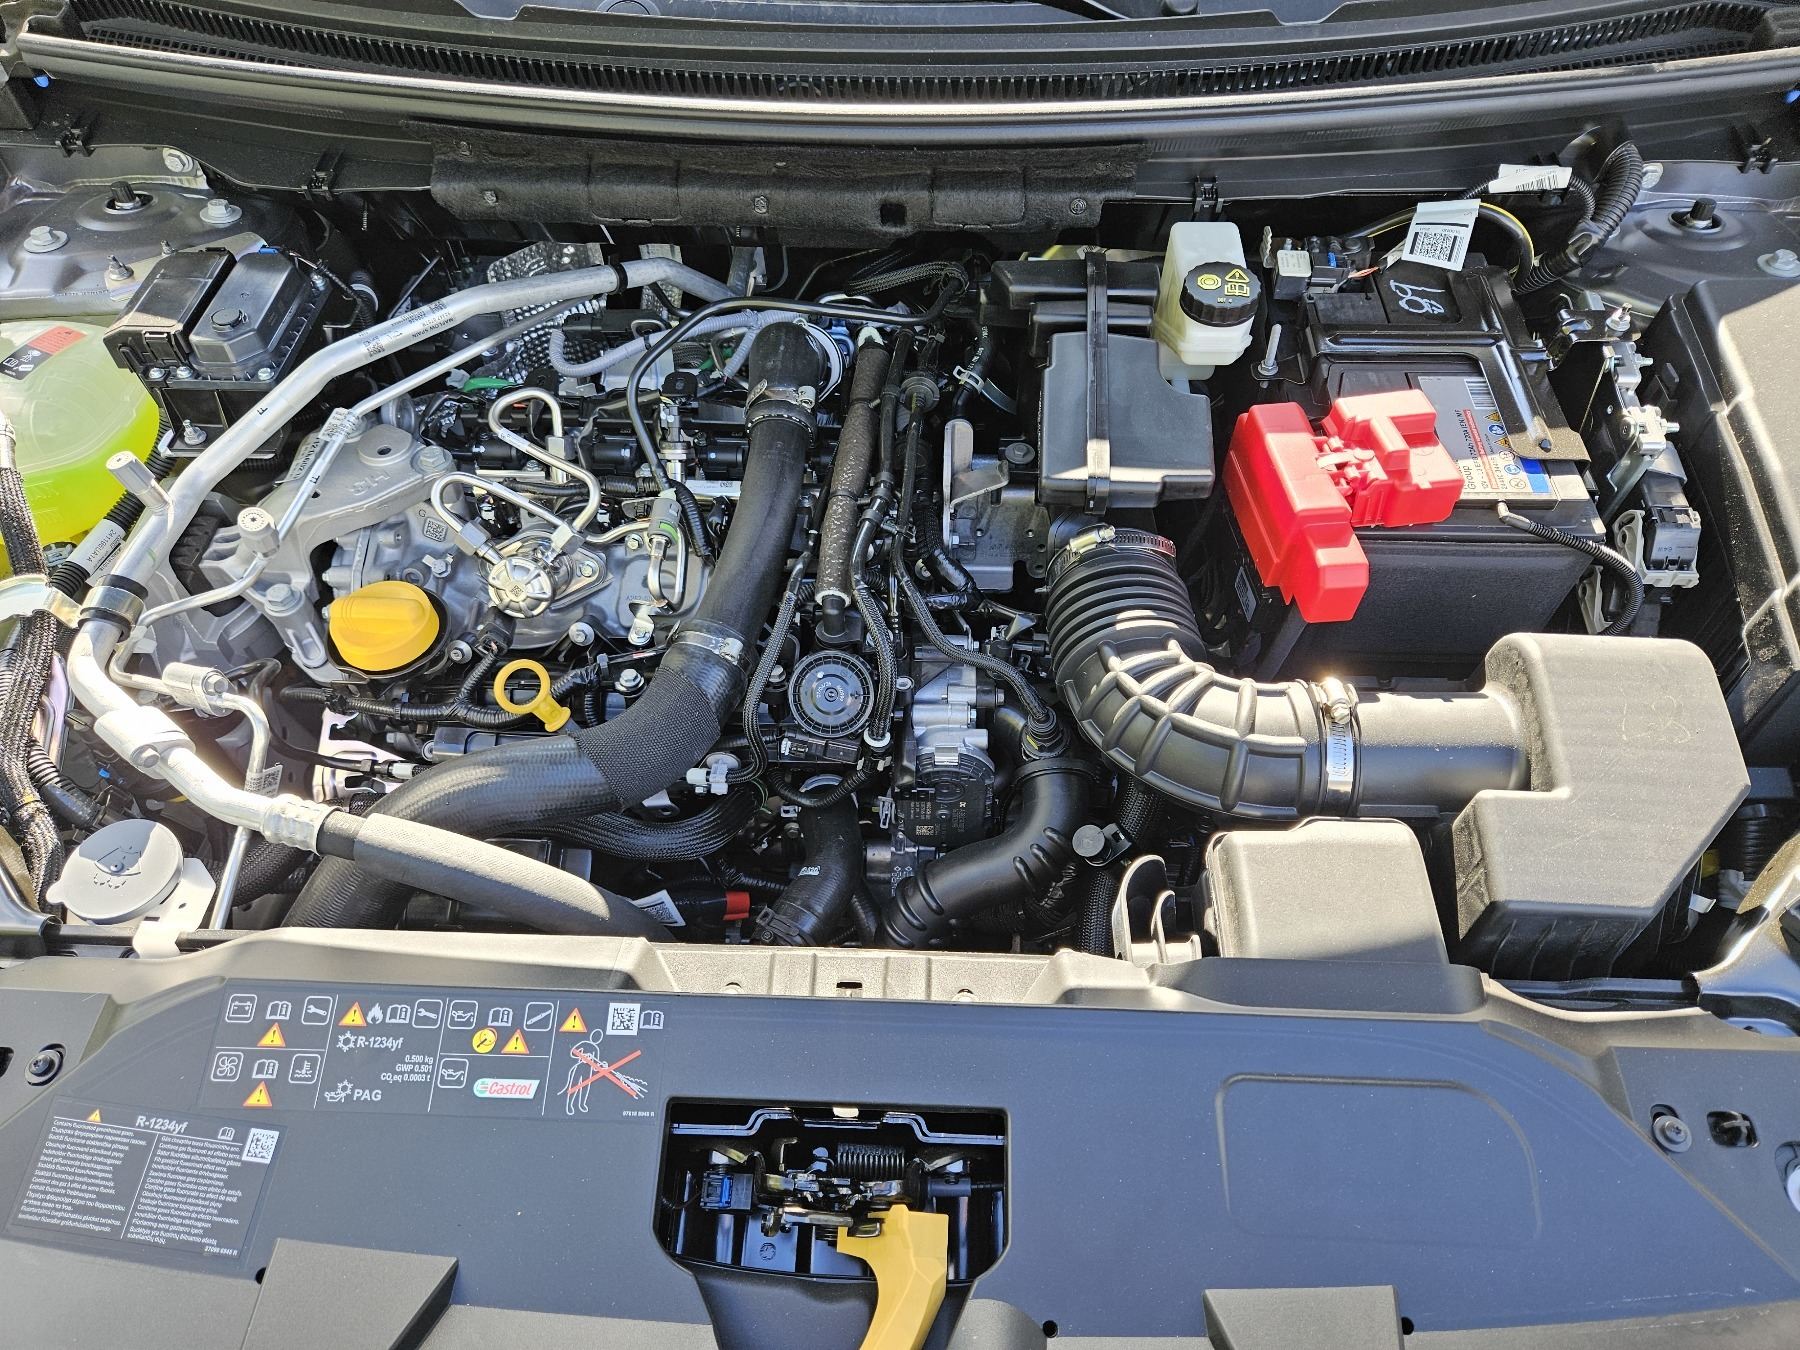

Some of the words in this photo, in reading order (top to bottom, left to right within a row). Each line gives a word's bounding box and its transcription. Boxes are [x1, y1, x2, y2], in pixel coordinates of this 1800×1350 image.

[356, 1036, 403, 1049] R-1234yf
[424, 1056, 434, 1065] kg
[396, 1064, 413, 1072] GWP
[414, 1064, 433, 1073] 0.501
[489, 1081, 532, 1096] Castrol
[353, 1089, 382, 1101] PAG
[136, 1116, 188, 1133] R-1234yf
